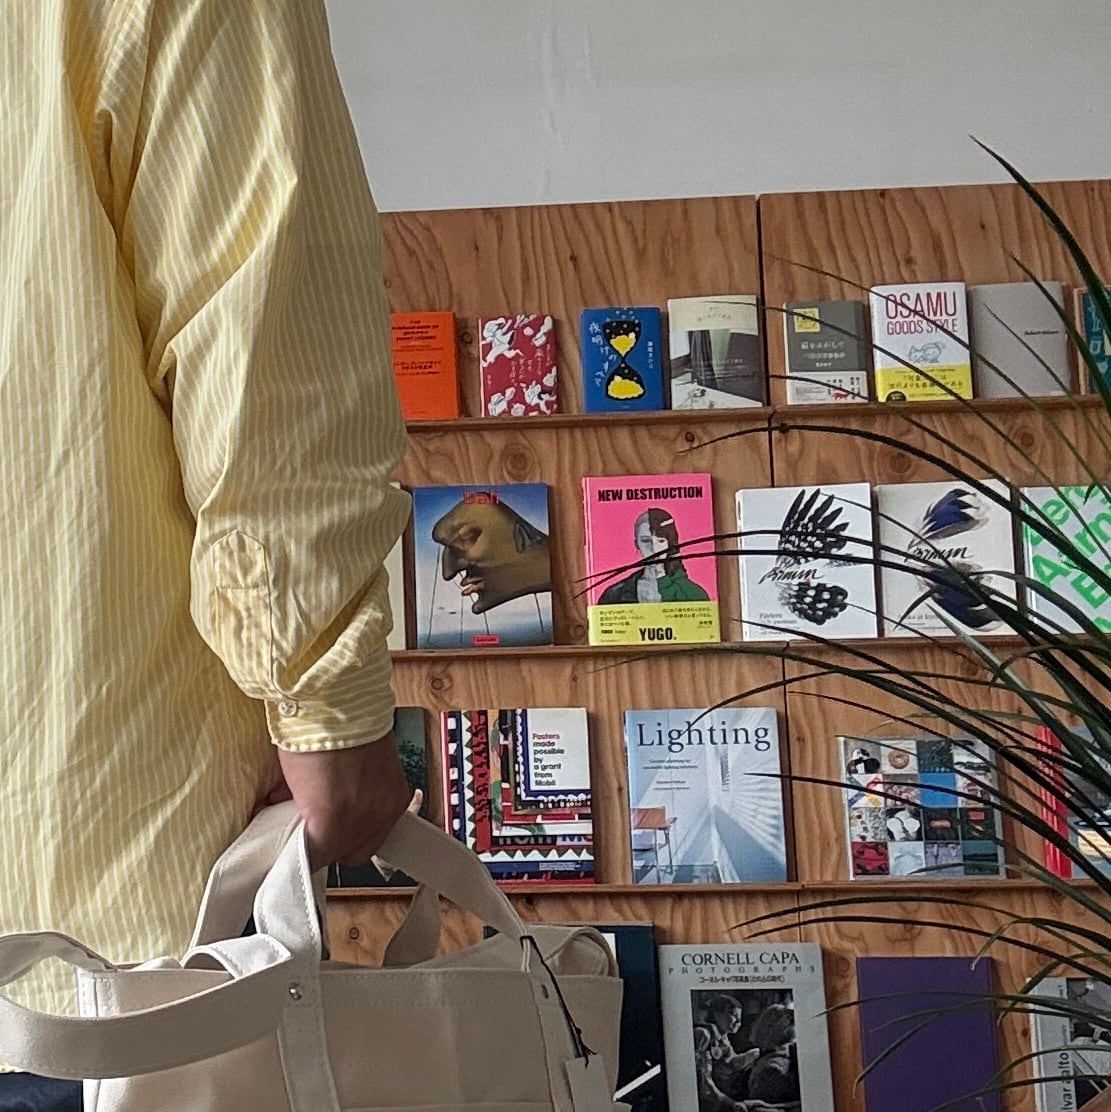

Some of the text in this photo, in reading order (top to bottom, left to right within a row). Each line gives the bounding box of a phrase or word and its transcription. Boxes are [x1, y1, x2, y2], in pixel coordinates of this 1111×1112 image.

[884, 291, 957, 320] OSAMU
[886, 320, 924, 336] GOODS
[597, 486, 704, 502] NEW DESTRUCTION
[638, 627, 678, 641] YUGO.
[637, 721, 771, 753] Lighting
[681, 951, 800, 966] CORNELL CAPA
